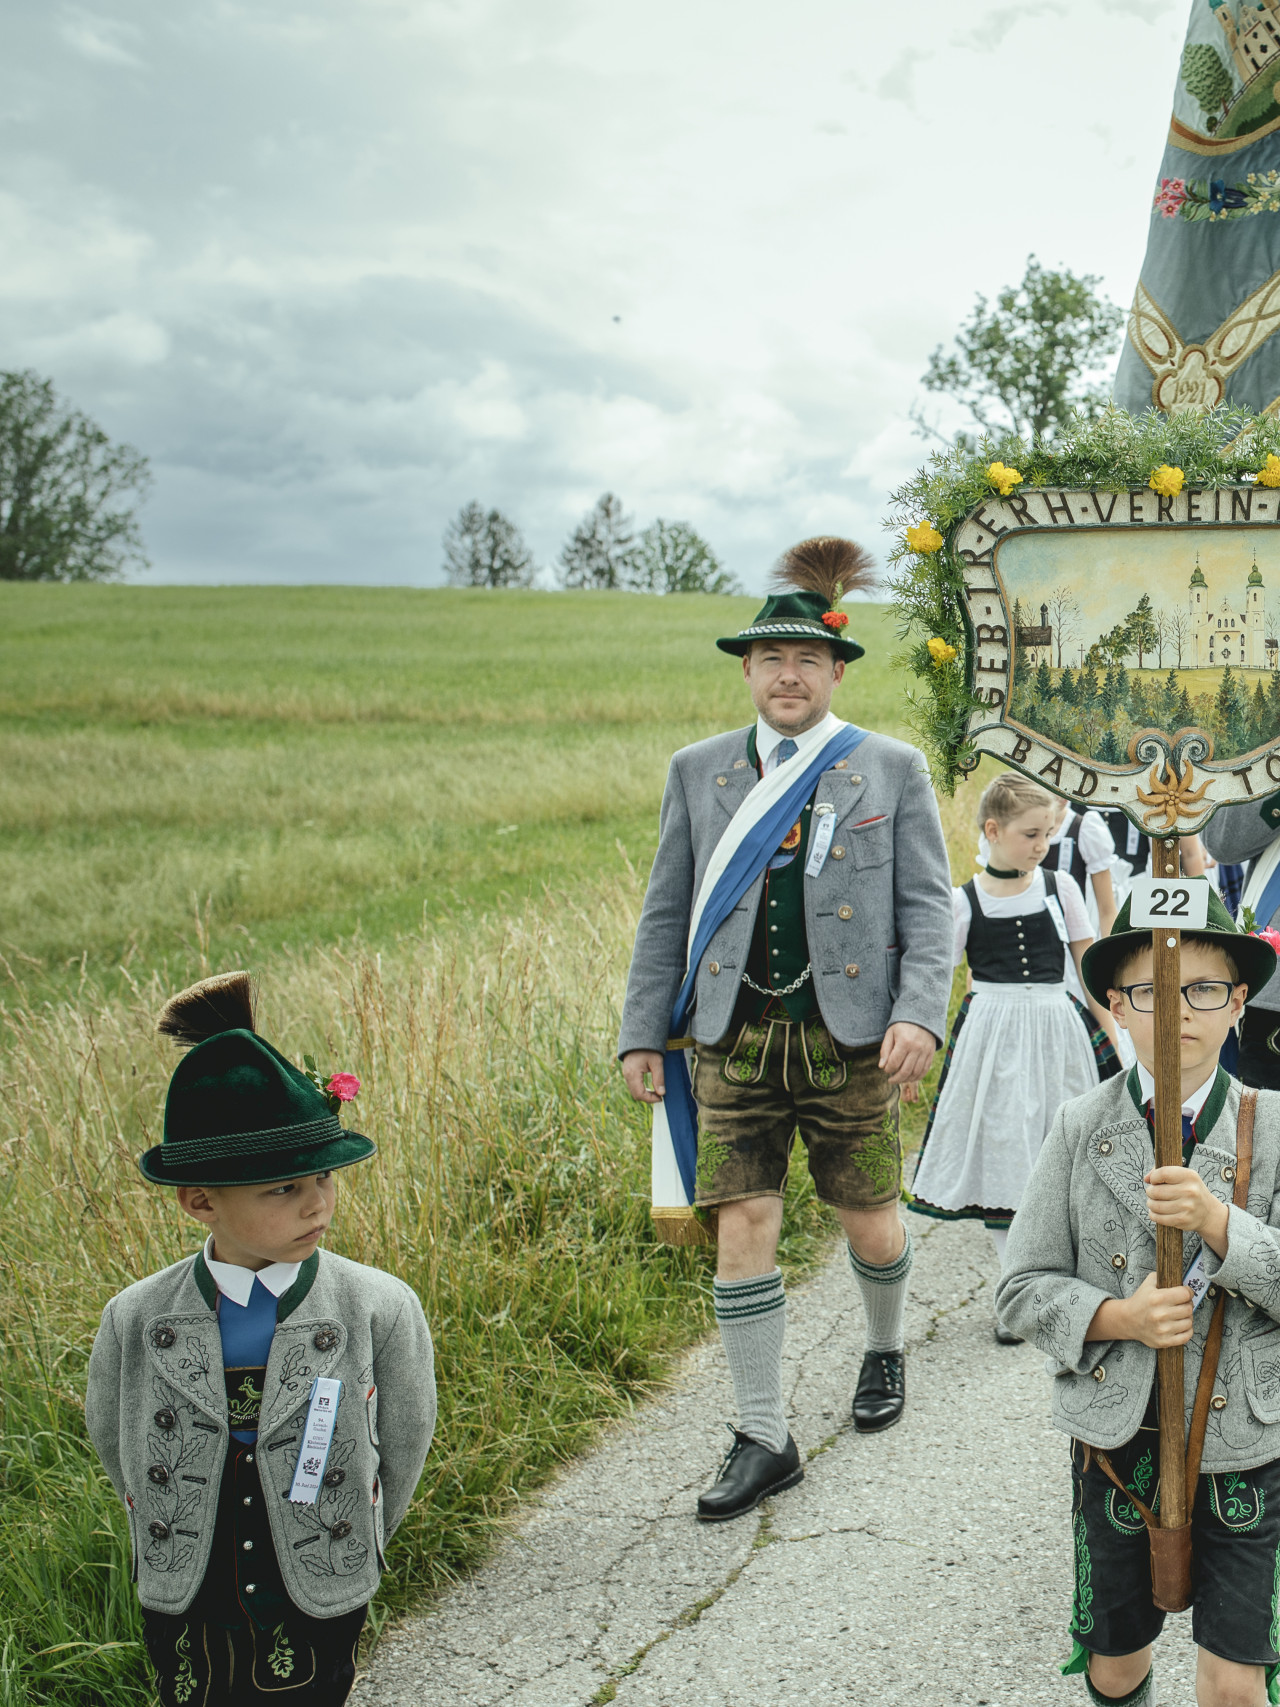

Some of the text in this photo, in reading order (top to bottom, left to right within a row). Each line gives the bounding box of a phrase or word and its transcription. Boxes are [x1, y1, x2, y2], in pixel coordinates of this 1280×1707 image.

[1172, 380, 1206, 404] 1921
[1090, 489, 1253, 523] VEREIN
[1004, 733, 1098, 797] BAD
[1149, 888, 1190, 916] 22
